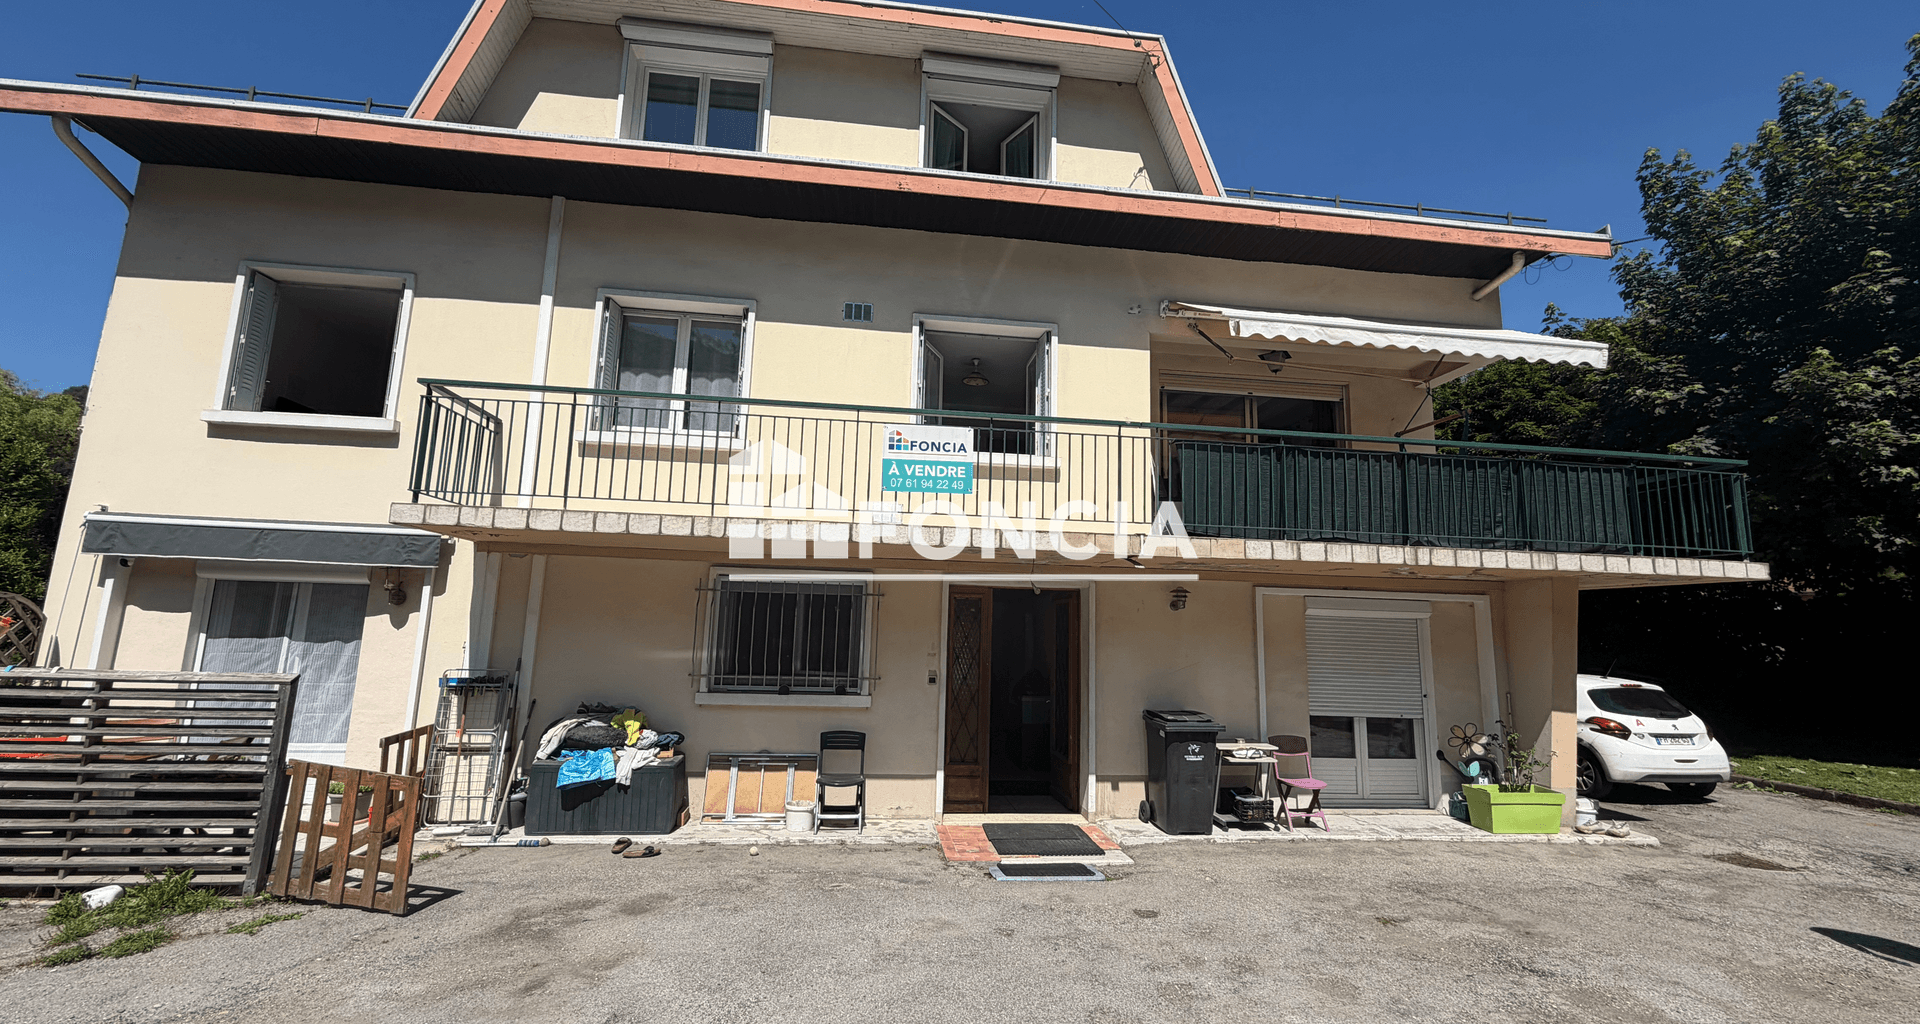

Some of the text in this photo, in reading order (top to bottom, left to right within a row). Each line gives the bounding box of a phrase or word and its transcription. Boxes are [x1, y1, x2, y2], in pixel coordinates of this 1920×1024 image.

[910, 441, 968, 453] FONCIA
[888, 460, 966, 477] À VENDRE
[890, 477, 964, 490] 07 61 94 22 49
